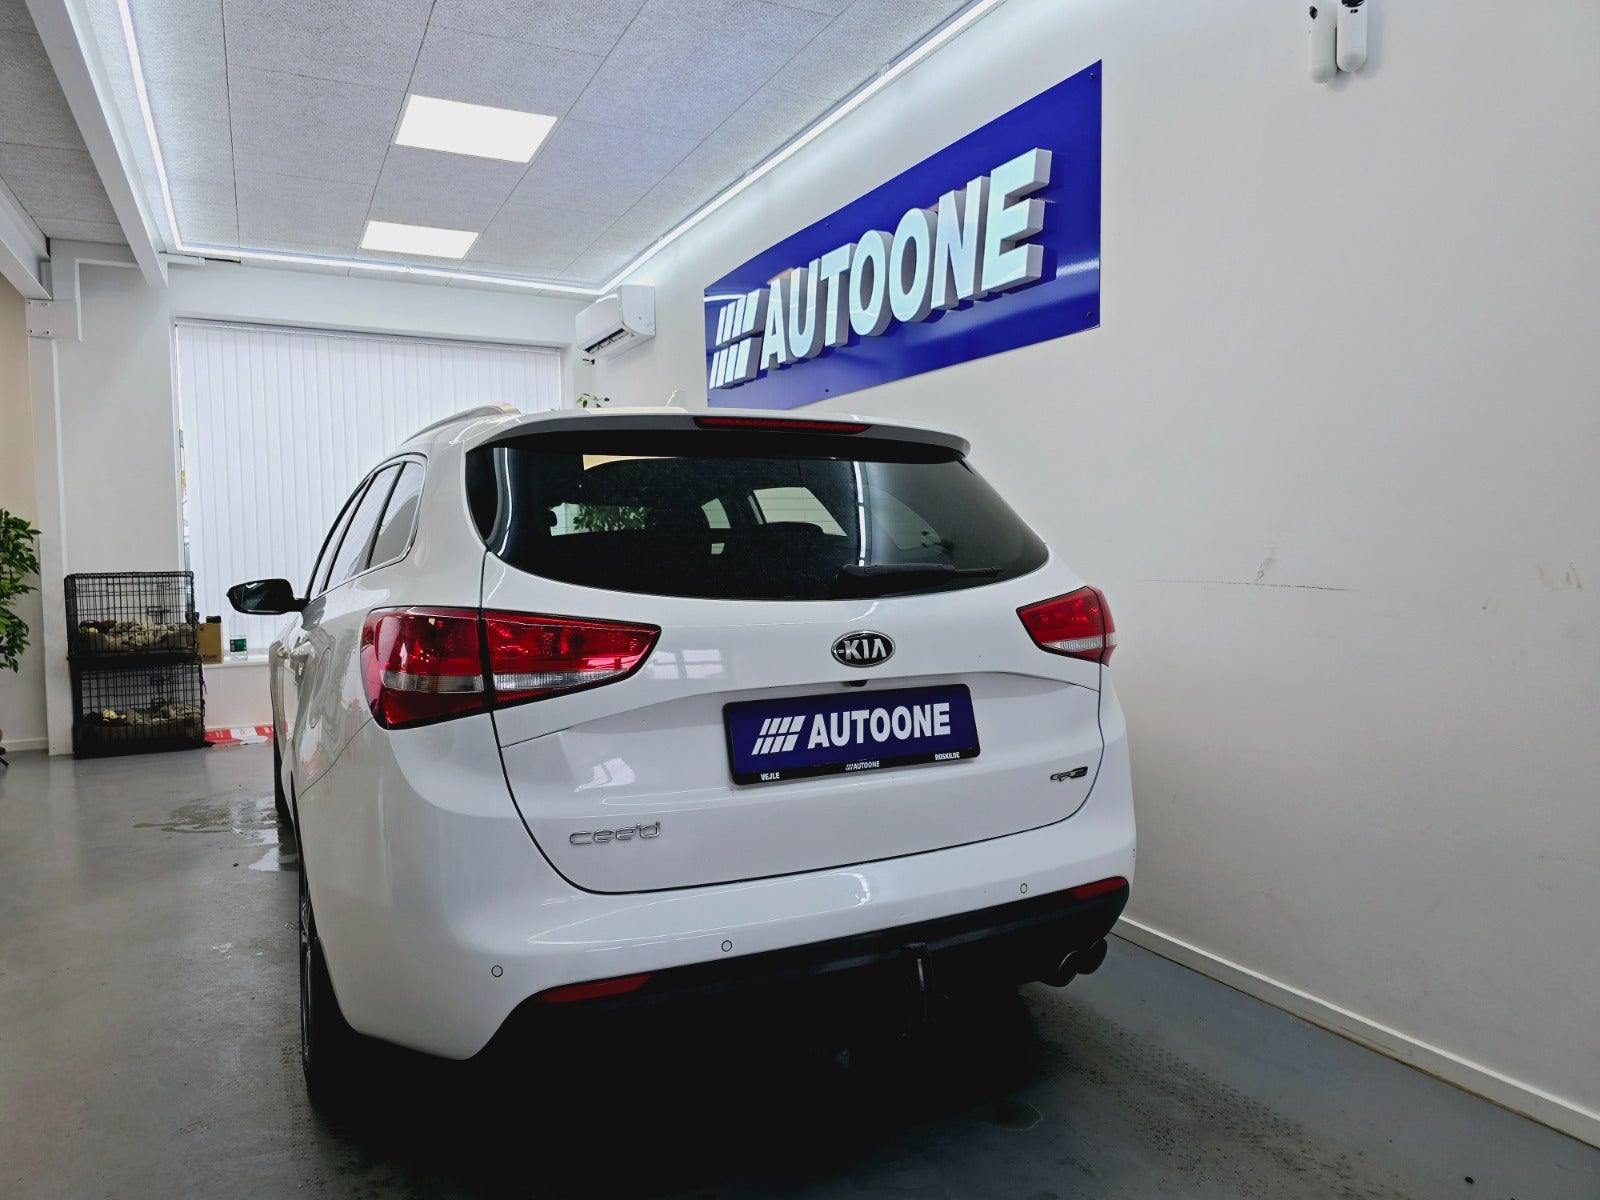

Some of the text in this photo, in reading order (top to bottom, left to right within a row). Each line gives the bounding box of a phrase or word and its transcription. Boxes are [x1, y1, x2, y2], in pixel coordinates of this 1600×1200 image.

[759, 147, 1052, 371] AUTOONE
[844, 638, 887, 659] KIA
[807, 702, 951, 750] AUTOONE
[934, 751, 960, 761] ROSKILDE
[853, 760, 880, 770] AUTOONE
[760, 771, 780, 781] VEJLE
